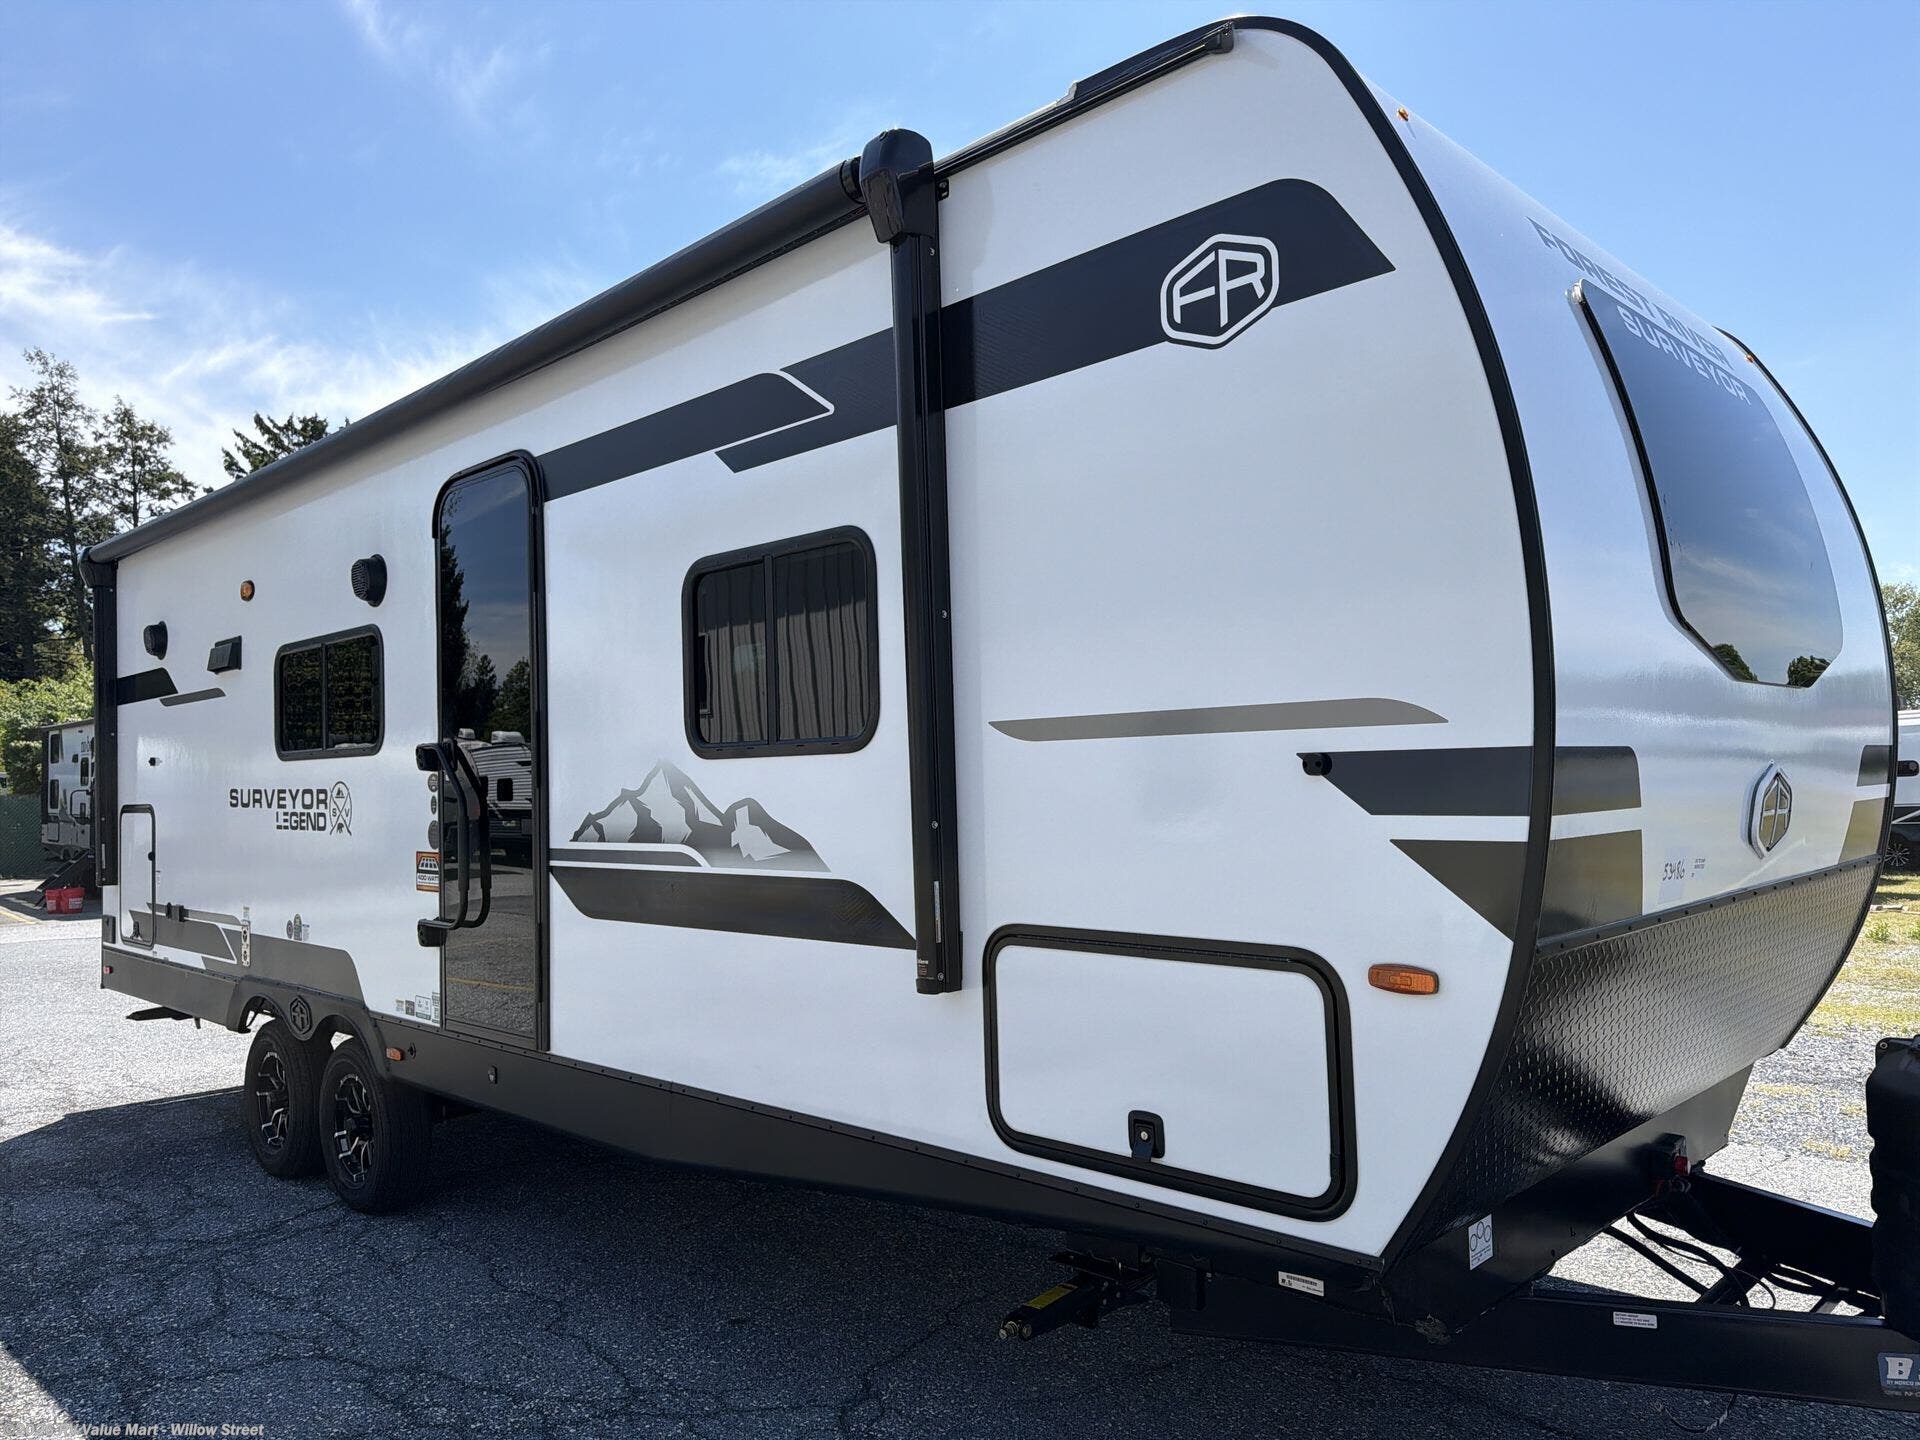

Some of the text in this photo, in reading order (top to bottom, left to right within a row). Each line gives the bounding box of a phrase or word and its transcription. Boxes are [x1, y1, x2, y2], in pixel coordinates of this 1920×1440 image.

[1526, 216, 1656, 318] FOREST
[1617, 304, 1752, 406] SURVEYOR
[229, 788, 329, 810] SURVEYOR
[276, 811, 327, 832] LEGEND
